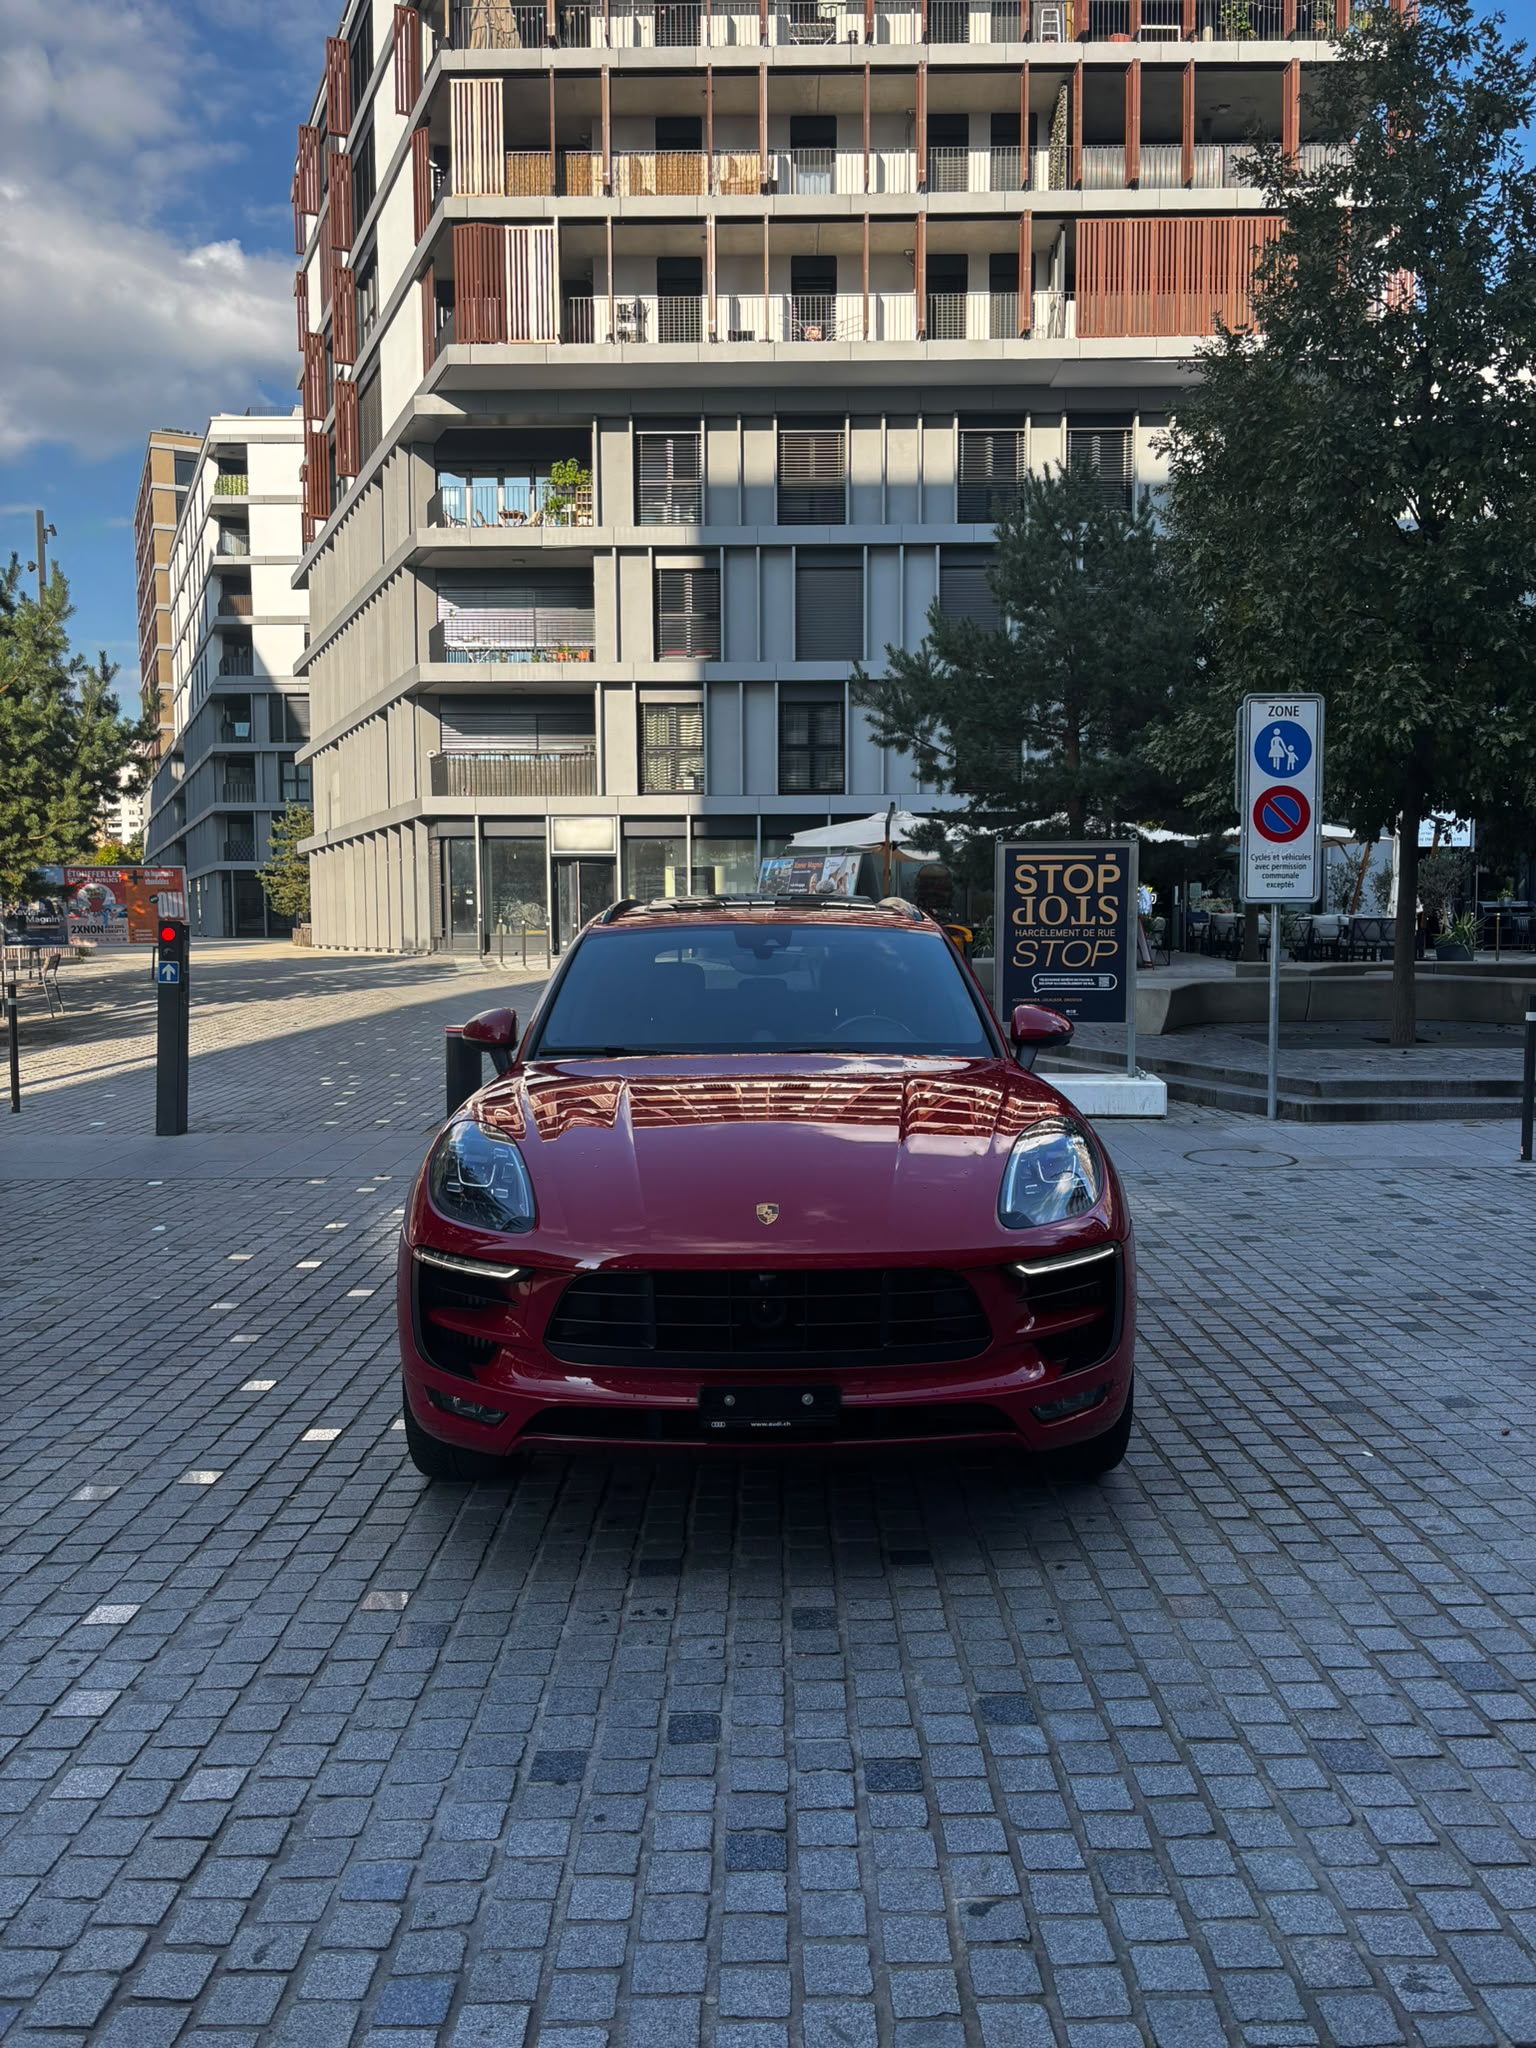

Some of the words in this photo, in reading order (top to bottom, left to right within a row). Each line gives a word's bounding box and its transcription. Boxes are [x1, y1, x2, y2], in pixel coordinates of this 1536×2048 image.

[1268, 705, 1300, 717] ZONE
[1250, 853, 1271, 862] Cycles
[1281, 853, 1312, 861] véhicules
[1271, 863, 1307, 871] permission
[108, 870, 121, 878] LES
[1014, 864, 1121, 894] STOP
[1266, 881, 1295, 889] exceptés
[157, 891, 184, 918] OUI
[11, 907, 41, 916] Xavier
[26, 915, 60, 925] Magnin
[1015, 927, 1081, 937] HARCÈLEMENT
[1083, 929, 1095, 937] DE
[1097, 929, 1116, 937] RUE
[1012, 940, 1119, 967] STOP
